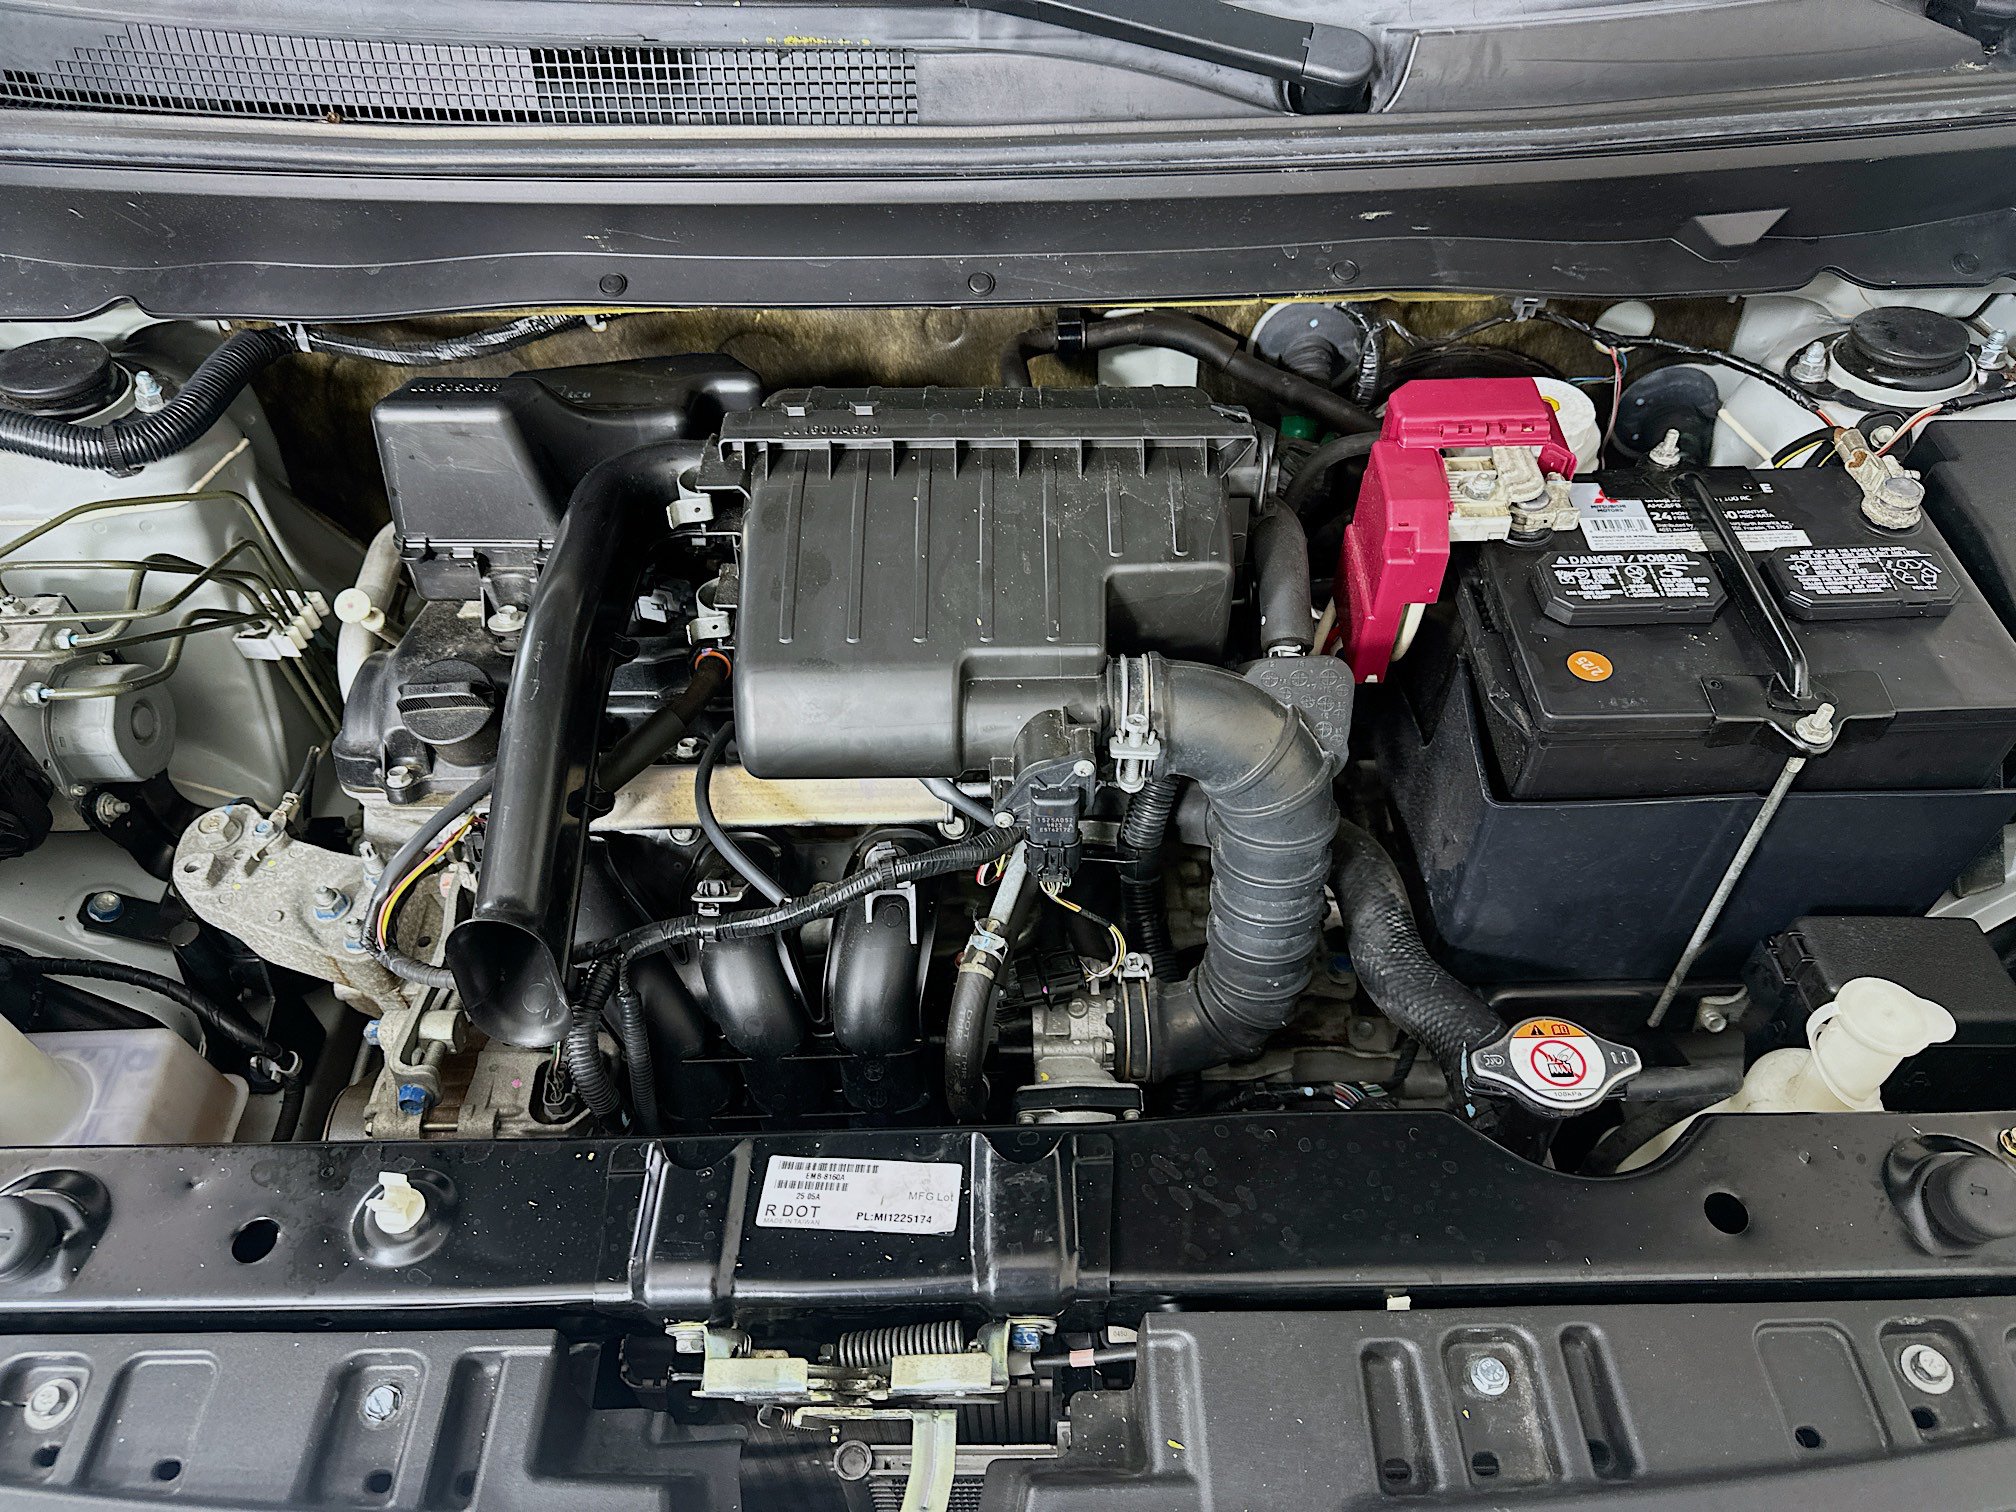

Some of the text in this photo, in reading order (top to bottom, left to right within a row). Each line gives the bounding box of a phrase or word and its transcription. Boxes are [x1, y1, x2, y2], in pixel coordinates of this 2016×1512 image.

[1649, 511, 1672, 521] 24
[1568, 555, 1625, 564] DANGER
[1638, 553, 1689, 562] POISON
[1576, 656, 1604, 676] 2/25
[1610, 1051, 1630, 1064] 1.1
[908, 1191, 955, 1203] MFG Lot
[765, 1204, 821, 1218] R DOT
[794, 1218, 821, 1226] TAIWAN
[856, 1212, 932, 1224] PL:MI1225174
